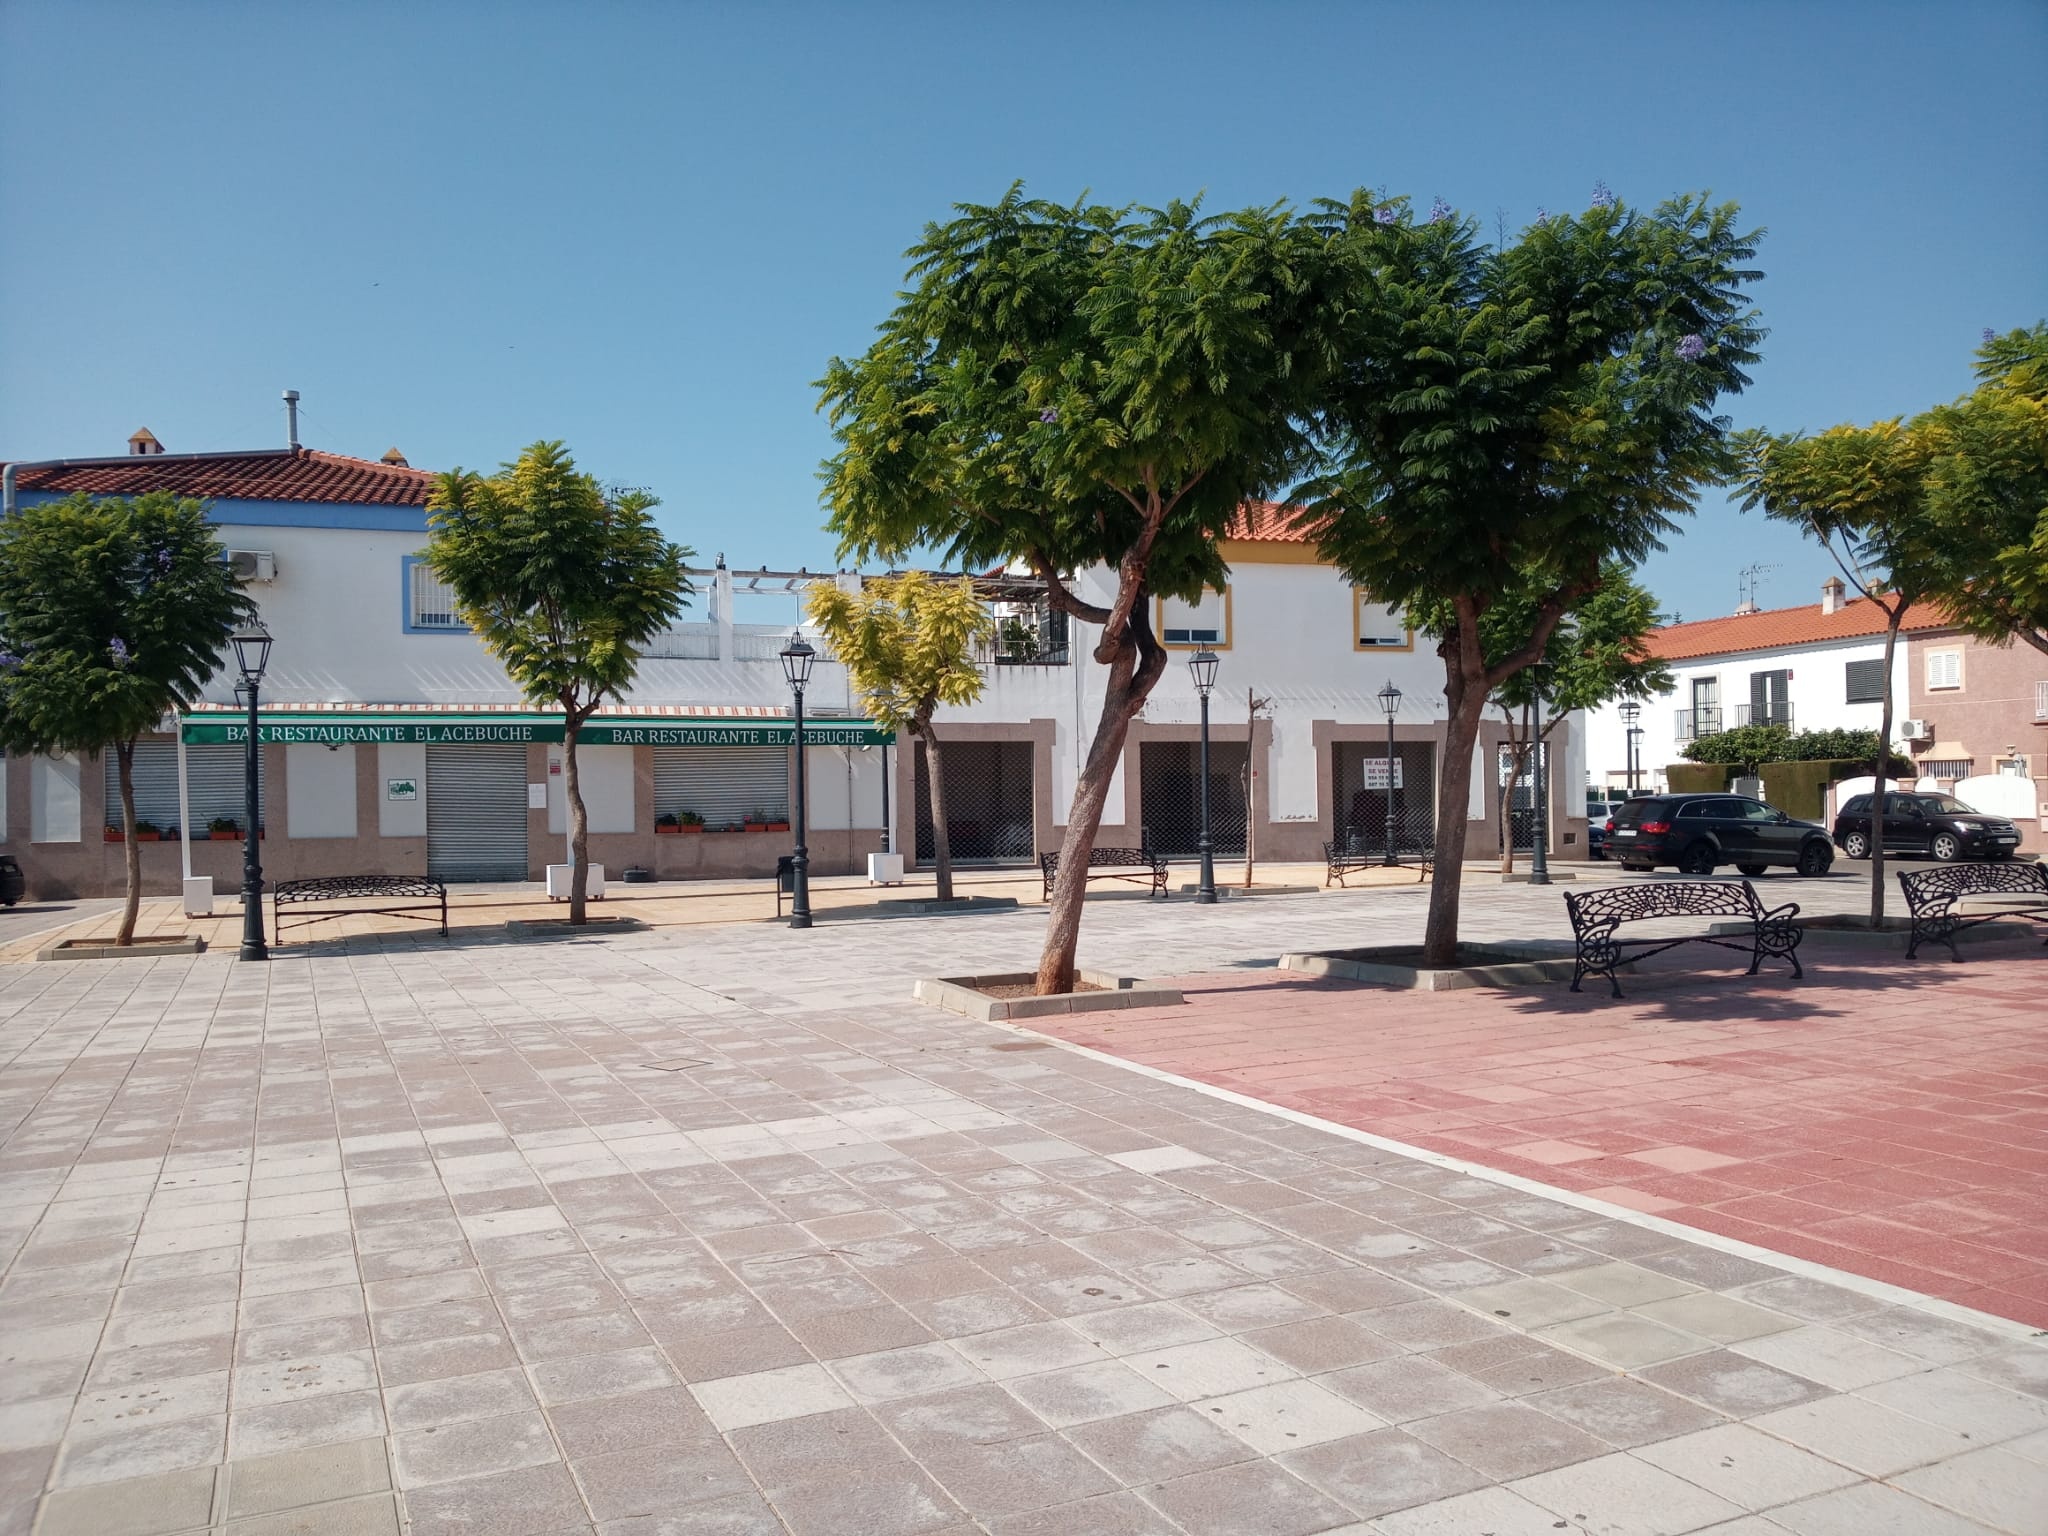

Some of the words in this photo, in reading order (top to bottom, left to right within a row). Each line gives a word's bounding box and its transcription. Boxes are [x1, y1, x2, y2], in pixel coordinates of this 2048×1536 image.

[226, 726, 265, 741] BAR
[271, 726, 405, 741] RESTAURANTE
[415, 726, 437, 741] EL
[441, 726, 533, 741] ACEBUCHE
[612, 729, 645, 743] BAR
[649, 730, 760, 744] RESTAURANTE
[767, 730, 785, 744] EL
